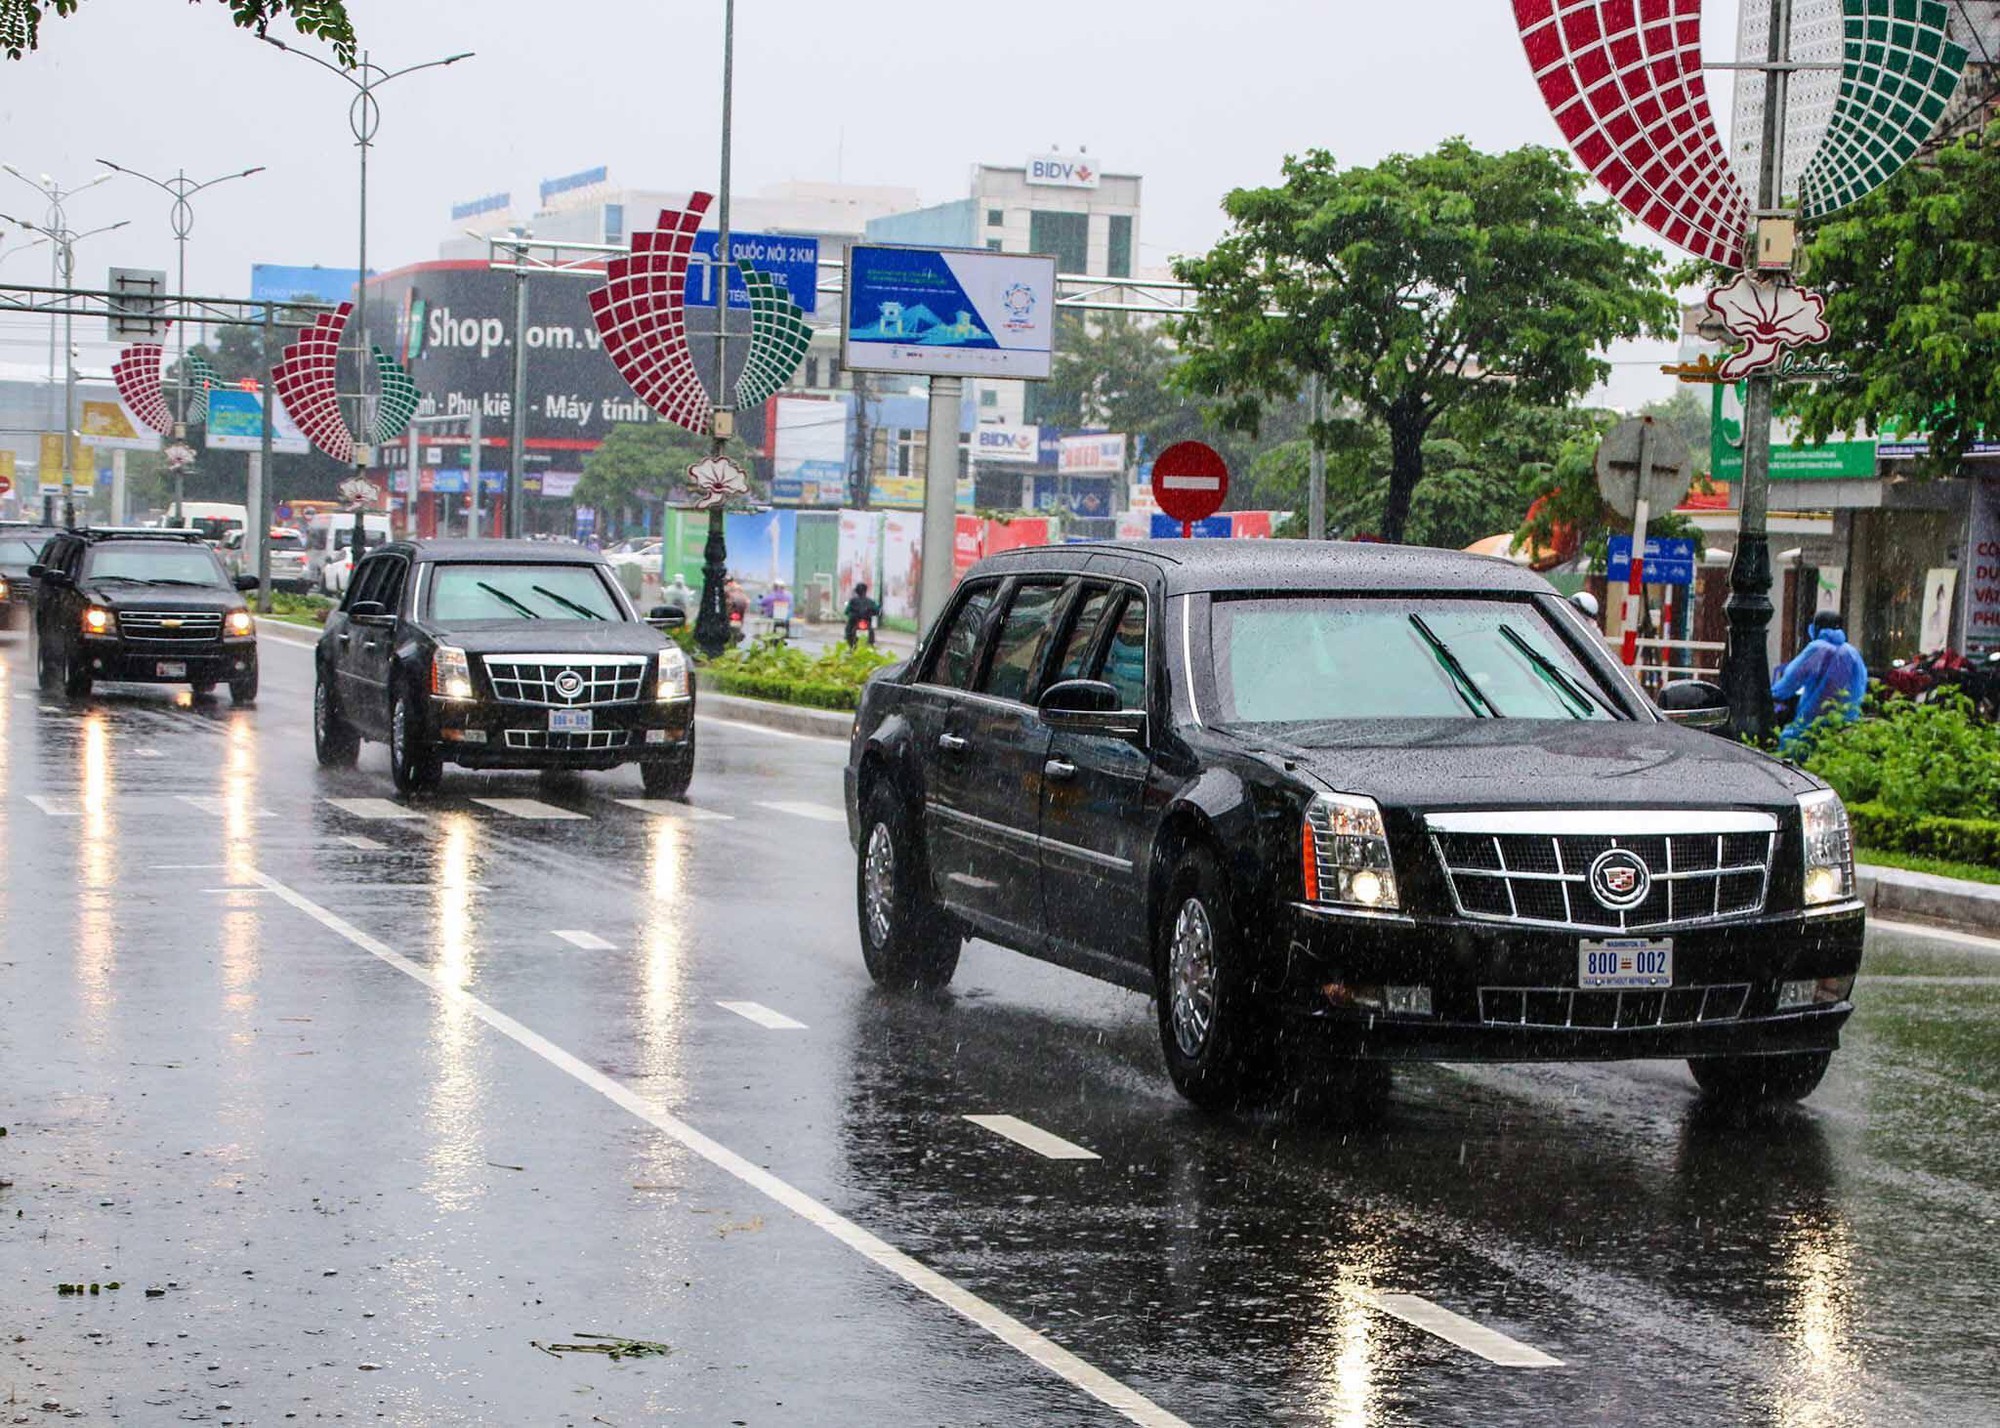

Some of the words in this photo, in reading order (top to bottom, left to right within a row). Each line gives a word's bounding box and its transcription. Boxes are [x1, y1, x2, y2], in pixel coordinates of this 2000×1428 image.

[1033, 161, 1074, 179] BIDV
[732, 239, 765, 260] QUỐC
[766, 243, 787, 263] NỘI
[789, 248, 796, 262] 2
[797, 248, 815, 263] KM
[1781, 350, 1849, 381] holiday
[546, 395, 593, 425] Máy
[601, 396, 648, 422] tính
[979, 431, 1016, 447] BIDV
[1588, 952, 1617, 974] 800
[1637, 951, 1665, 974] 002
